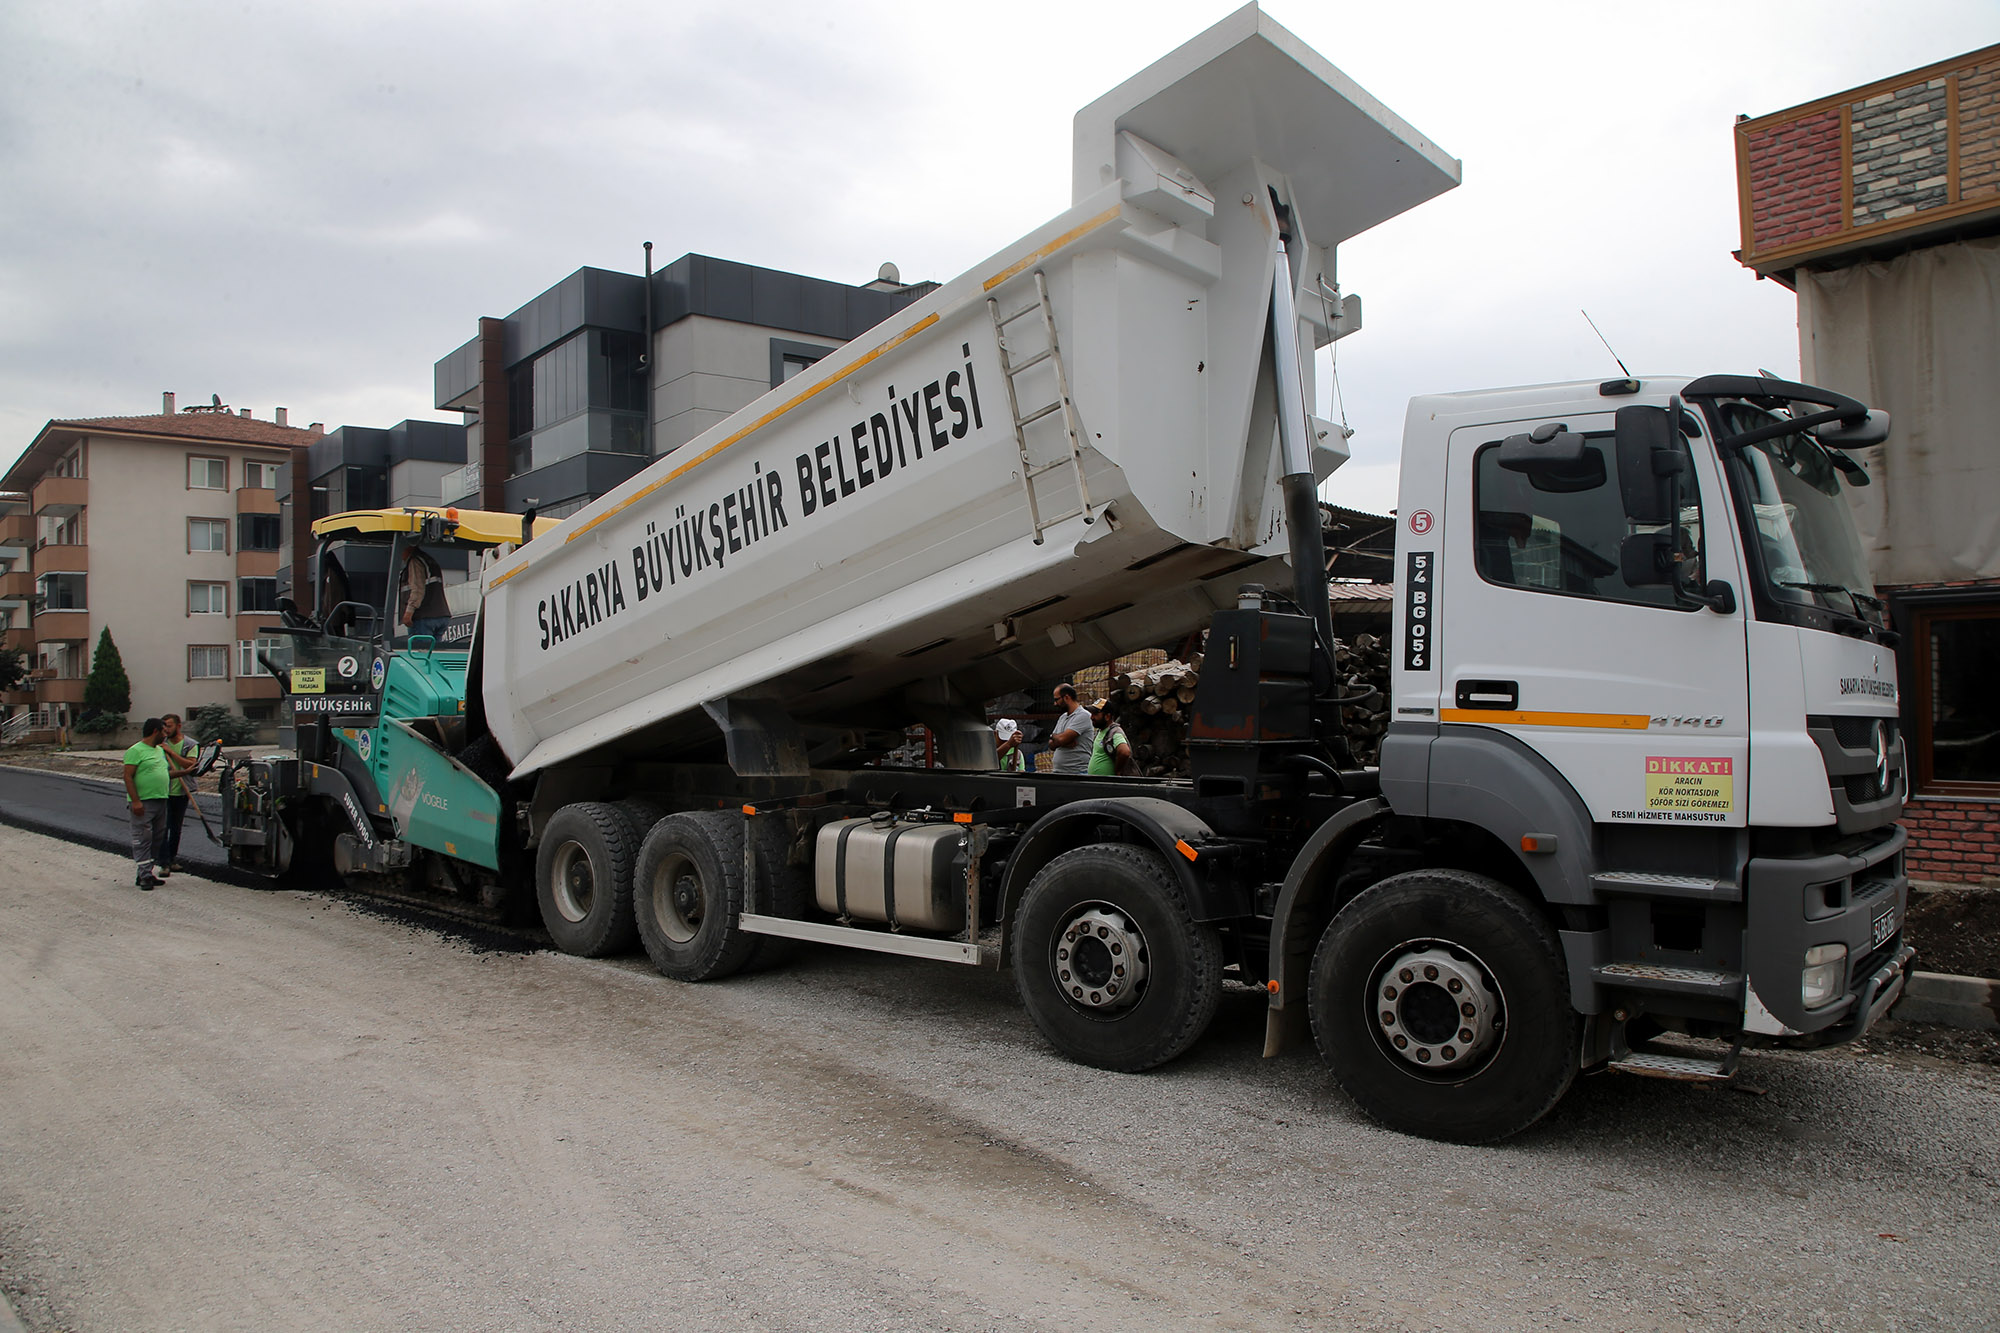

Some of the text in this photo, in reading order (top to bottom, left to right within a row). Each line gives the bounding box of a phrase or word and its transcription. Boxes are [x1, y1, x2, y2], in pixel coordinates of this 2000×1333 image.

[537, 342, 983, 650] SAKARYA BÜYÜKŞEHİR BELEDİYESİ
[1415, 513, 1428, 531] 5
[1412, 555, 1427, 667] 54 BG 056
[342, 658, 353, 675] 2
[295, 697, 372, 712] BÜYÜKŞEHİR
[1650, 715, 1724, 728] 4140
[1649, 759, 1729, 773] DİKKAT!
[1674, 777, 1702, 785] ARACIN
[1658, 786, 1720, 797] KÖR NOKTASIDIR
[343, 792, 359, 821] SUPER
[422, 792, 448, 810] VÖGELE
[1650, 797, 1729, 808] ŞÖFÖR SİZİ GÖREMEZ!
[1611, 810, 1726, 821] RESMİ HİZMETE MAHSUSTUR
